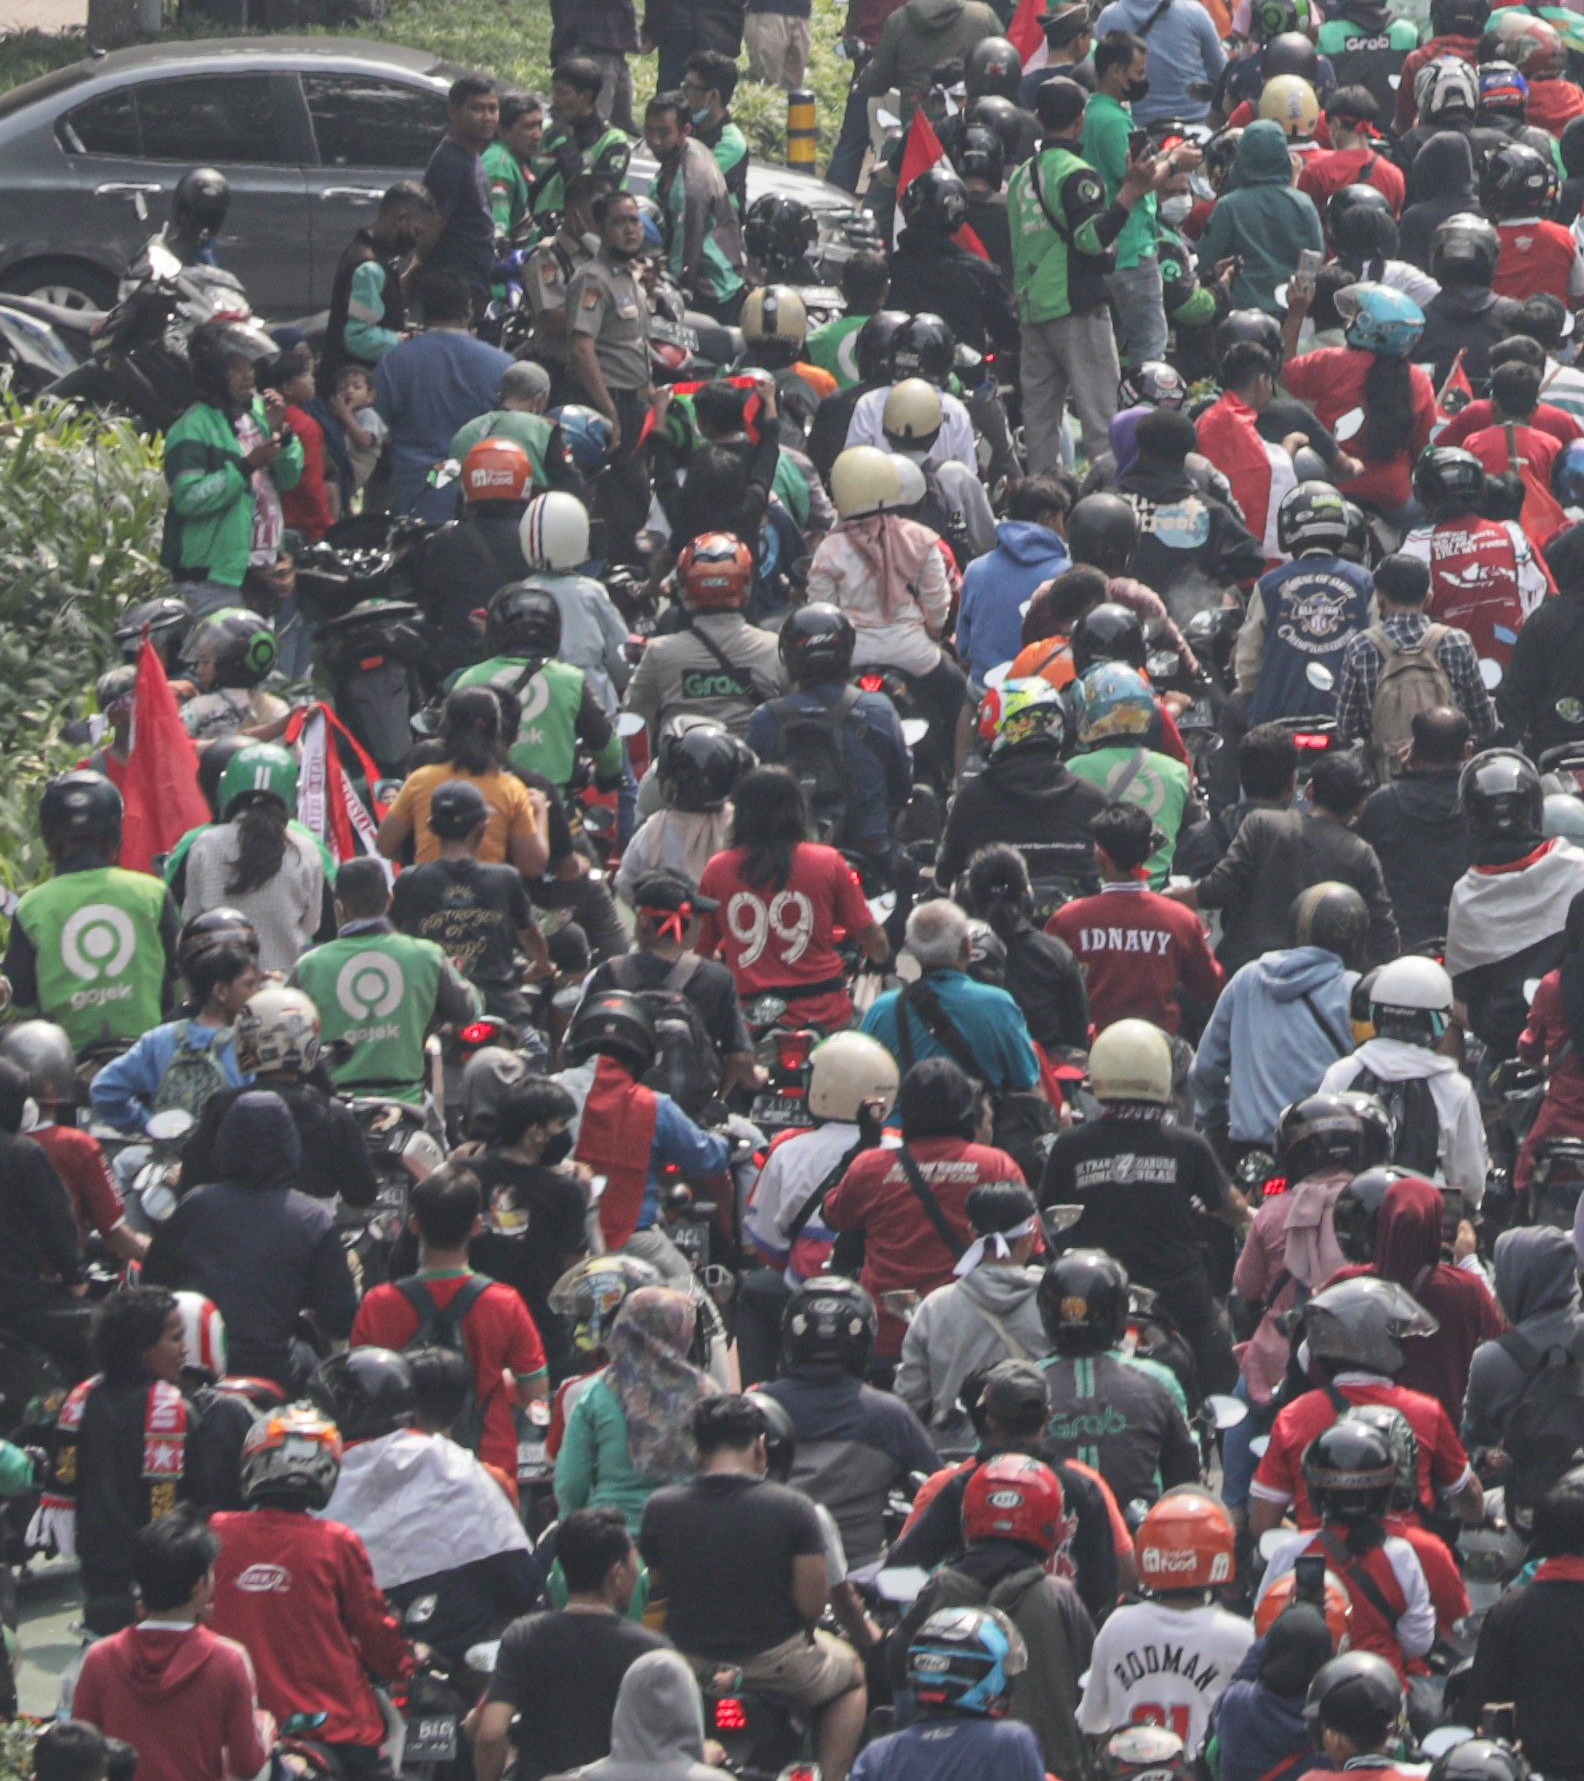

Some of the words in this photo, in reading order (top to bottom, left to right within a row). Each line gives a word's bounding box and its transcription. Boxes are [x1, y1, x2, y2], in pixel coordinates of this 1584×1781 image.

[1346, 36, 1390, 52] Grab
[685, 672, 744, 700] Gra
[727, 889, 816, 970] 99
[1079, 926, 1172, 957] IDNAVY
[71, 984, 133, 1013] gojek
[1047, 1404, 1128, 1440] Grab
[1114, 1643, 1219, 1692] RODMAN
